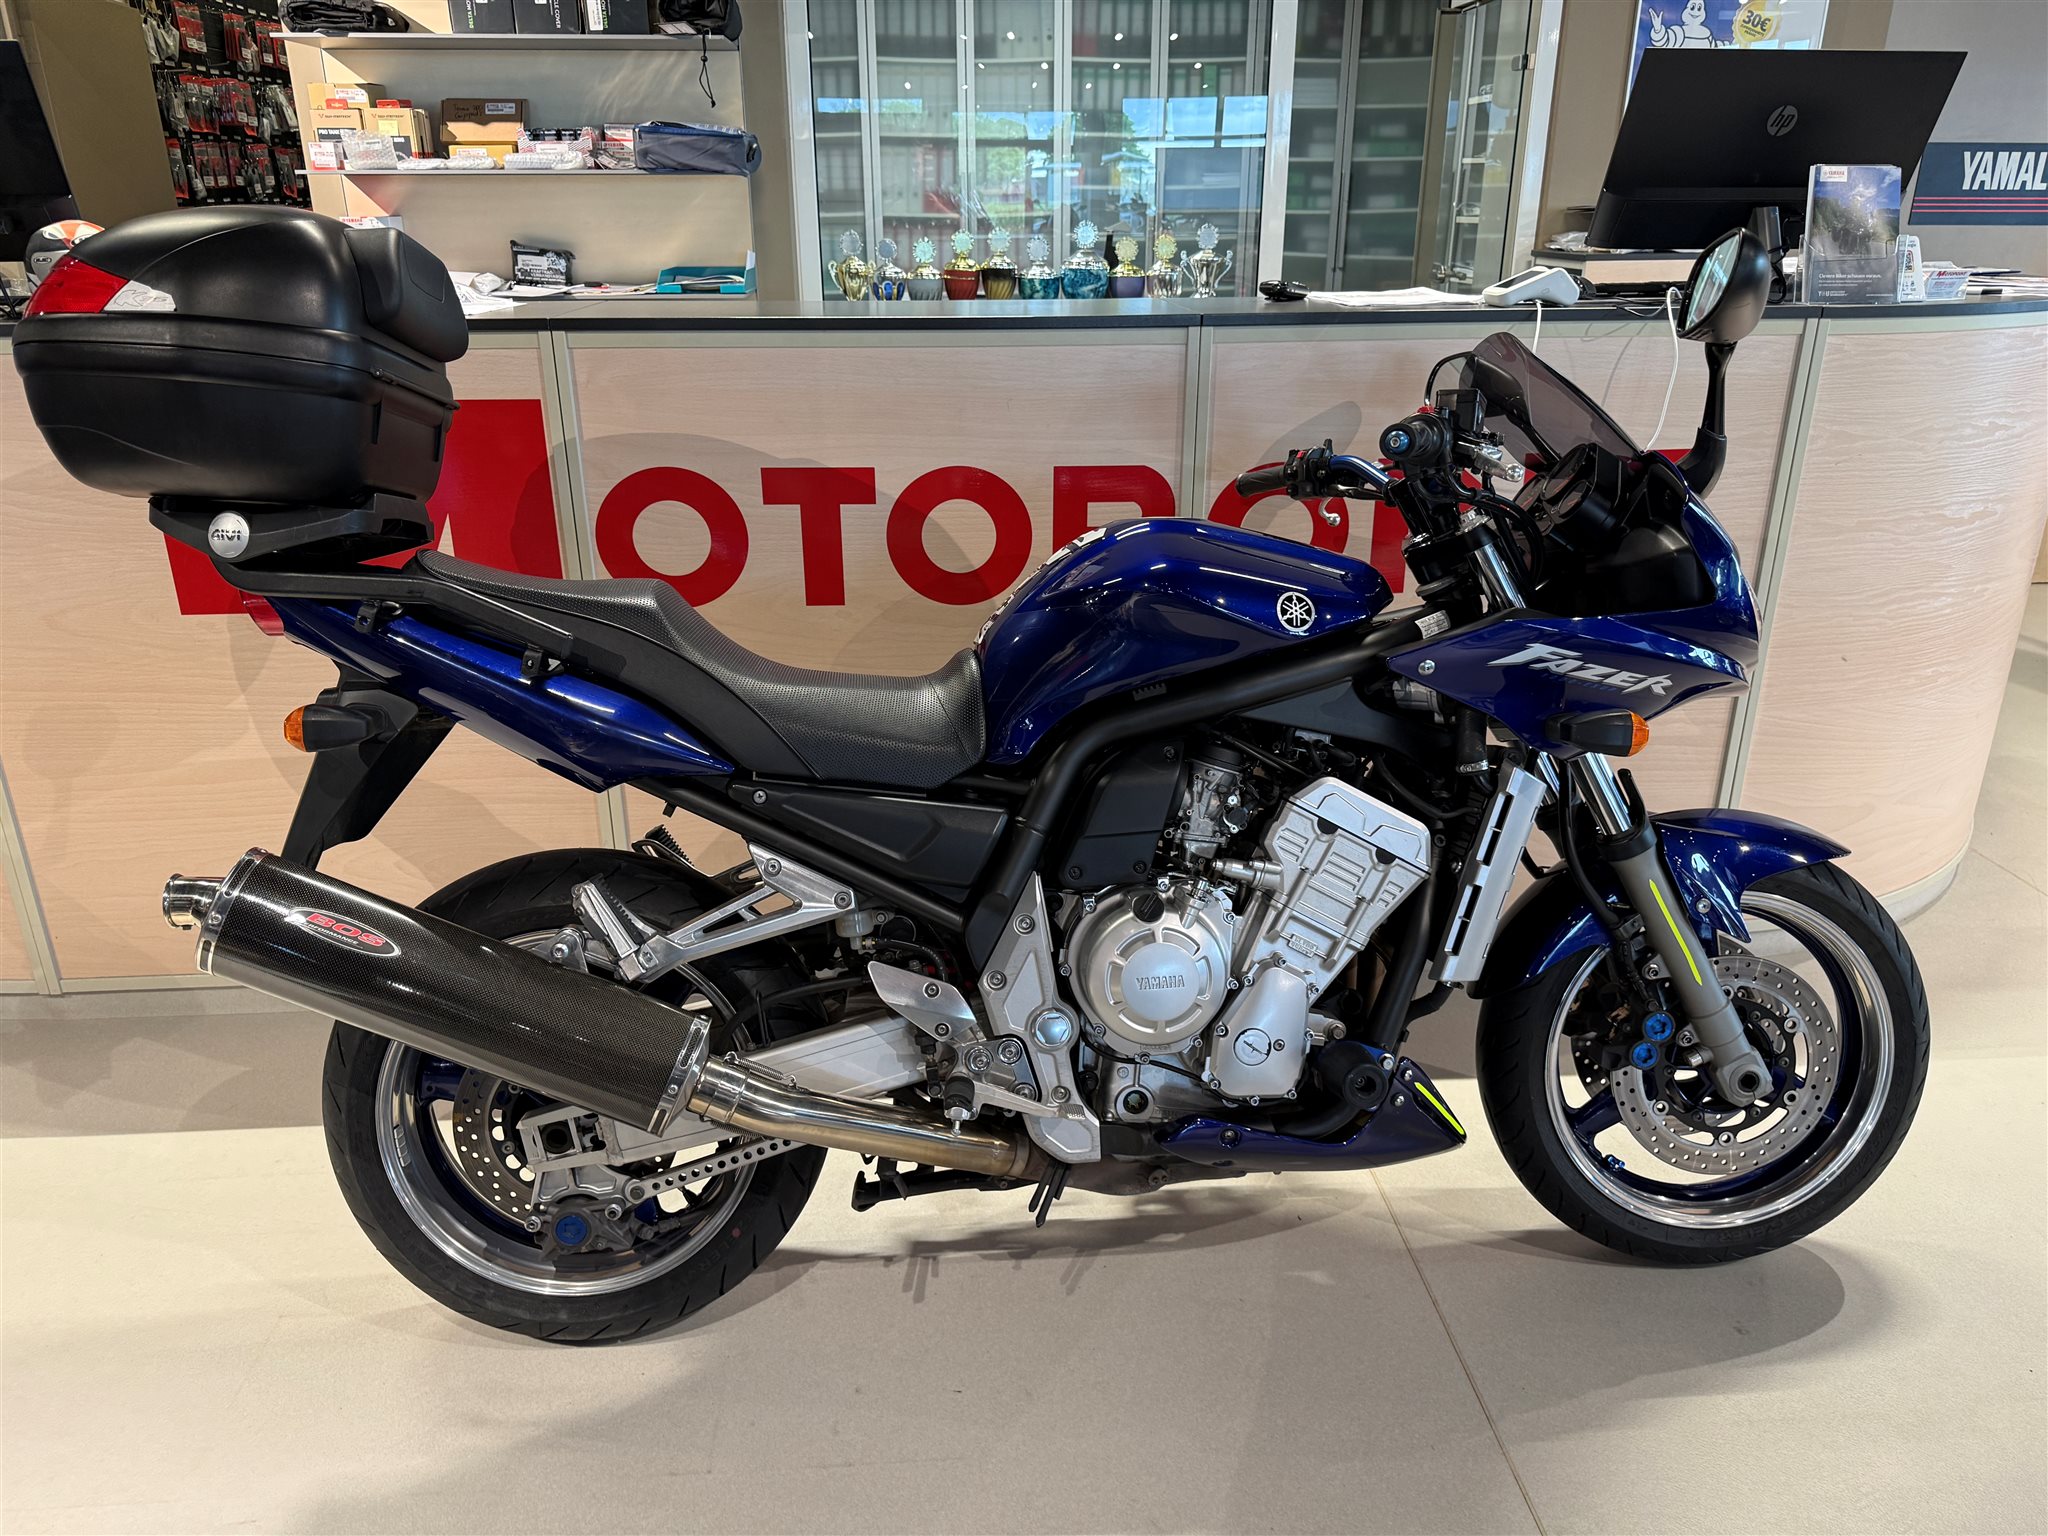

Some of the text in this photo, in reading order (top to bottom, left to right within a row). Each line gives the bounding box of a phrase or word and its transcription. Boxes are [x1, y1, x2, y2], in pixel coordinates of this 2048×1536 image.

[554, 9, 562, 29] COVER
[1742, 9, 1771, 32] 30€
[1487, 642, 1674, 696] FAZER
[298, 920, 360, 946] ERFORMANCE
[305, 912, 387, 948] BOS
[1135, 974, 1186, 991] YAMAHA
